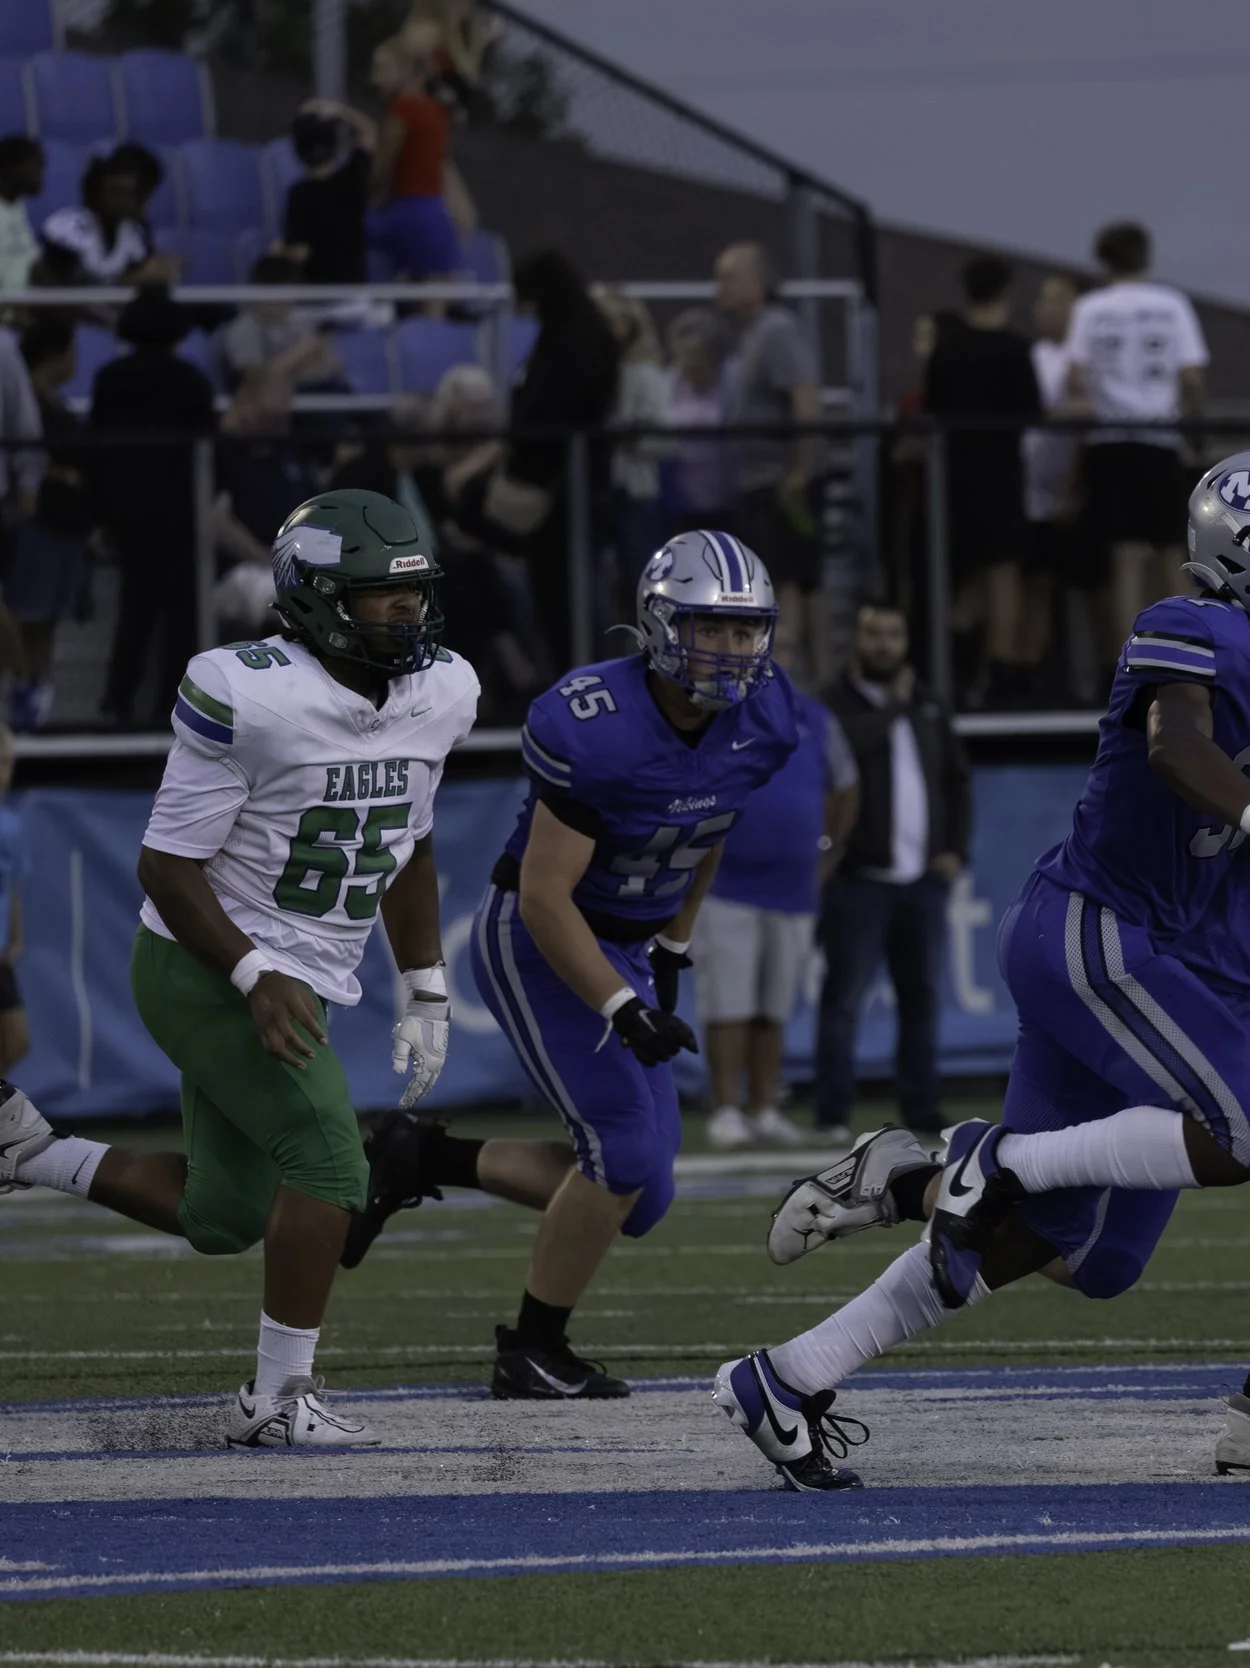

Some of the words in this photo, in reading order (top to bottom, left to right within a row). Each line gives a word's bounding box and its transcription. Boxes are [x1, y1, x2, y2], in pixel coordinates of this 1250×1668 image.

[558, 675, 618, 720] 45
[323, 759, 409, 802] EAGLES
[272, 802, 413, 920] 65
[609, 809, 736, 898] 45
